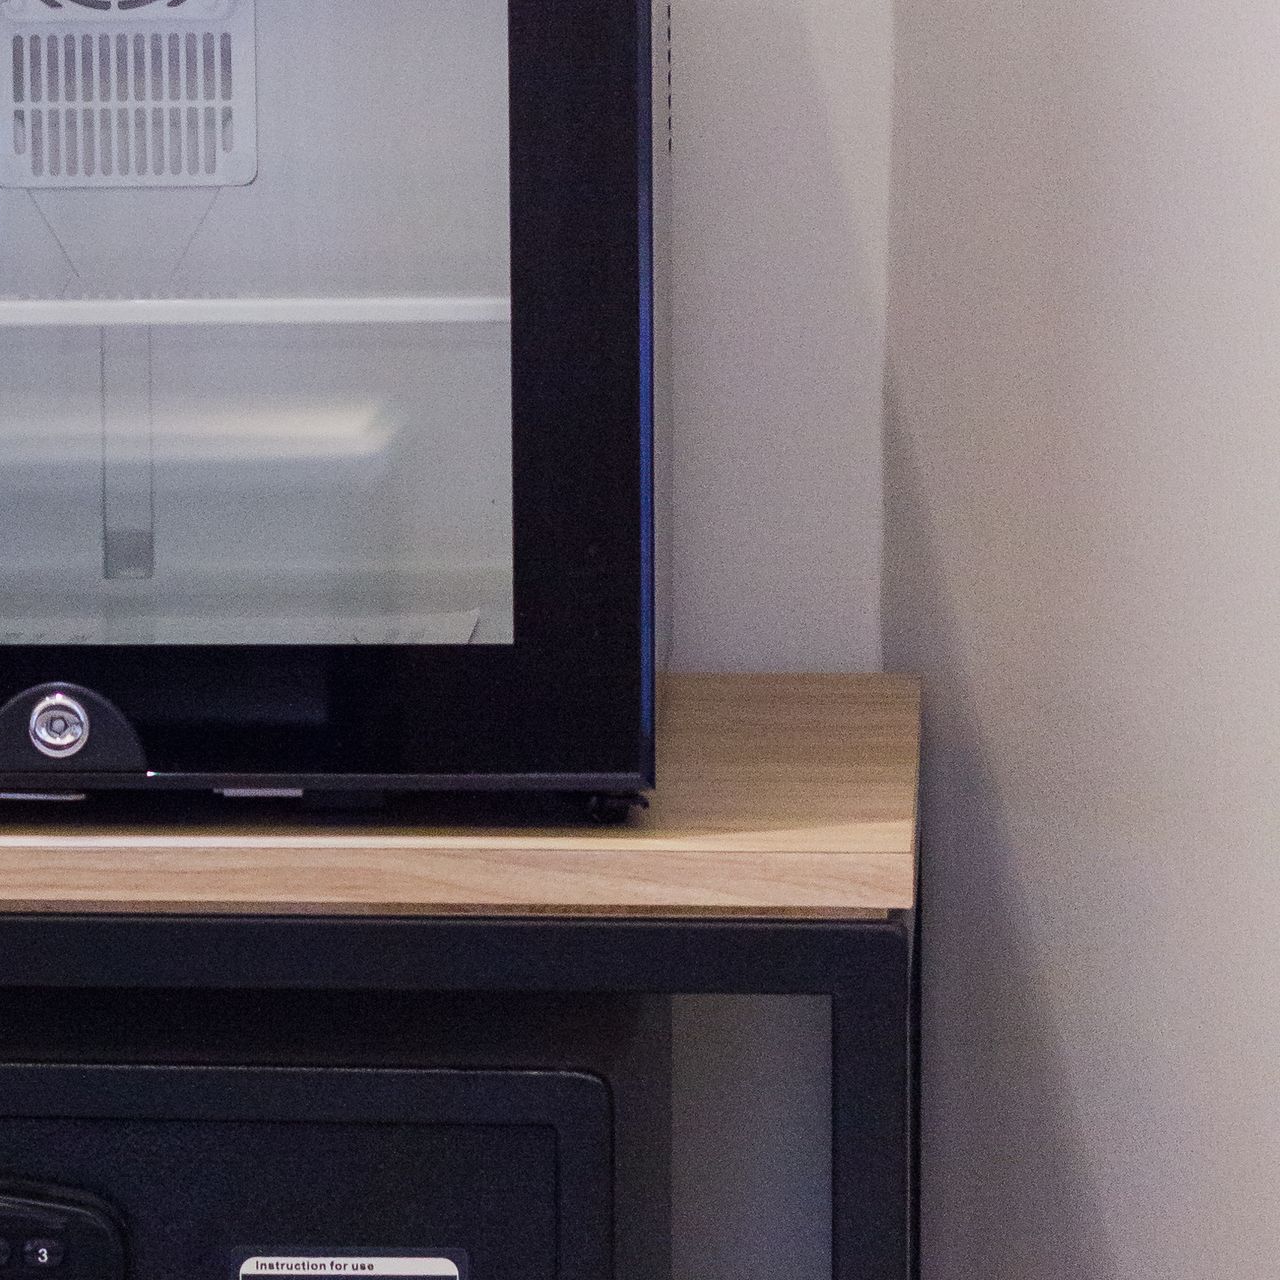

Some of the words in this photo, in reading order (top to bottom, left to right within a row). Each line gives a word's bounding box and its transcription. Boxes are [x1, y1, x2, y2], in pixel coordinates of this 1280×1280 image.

[37, 1248, 48, 1263] 3
[256, 1261, 326, 1271] Instruction
[330, 1261, 347, 1271] for
[352, 1263, 374, 1271] use
